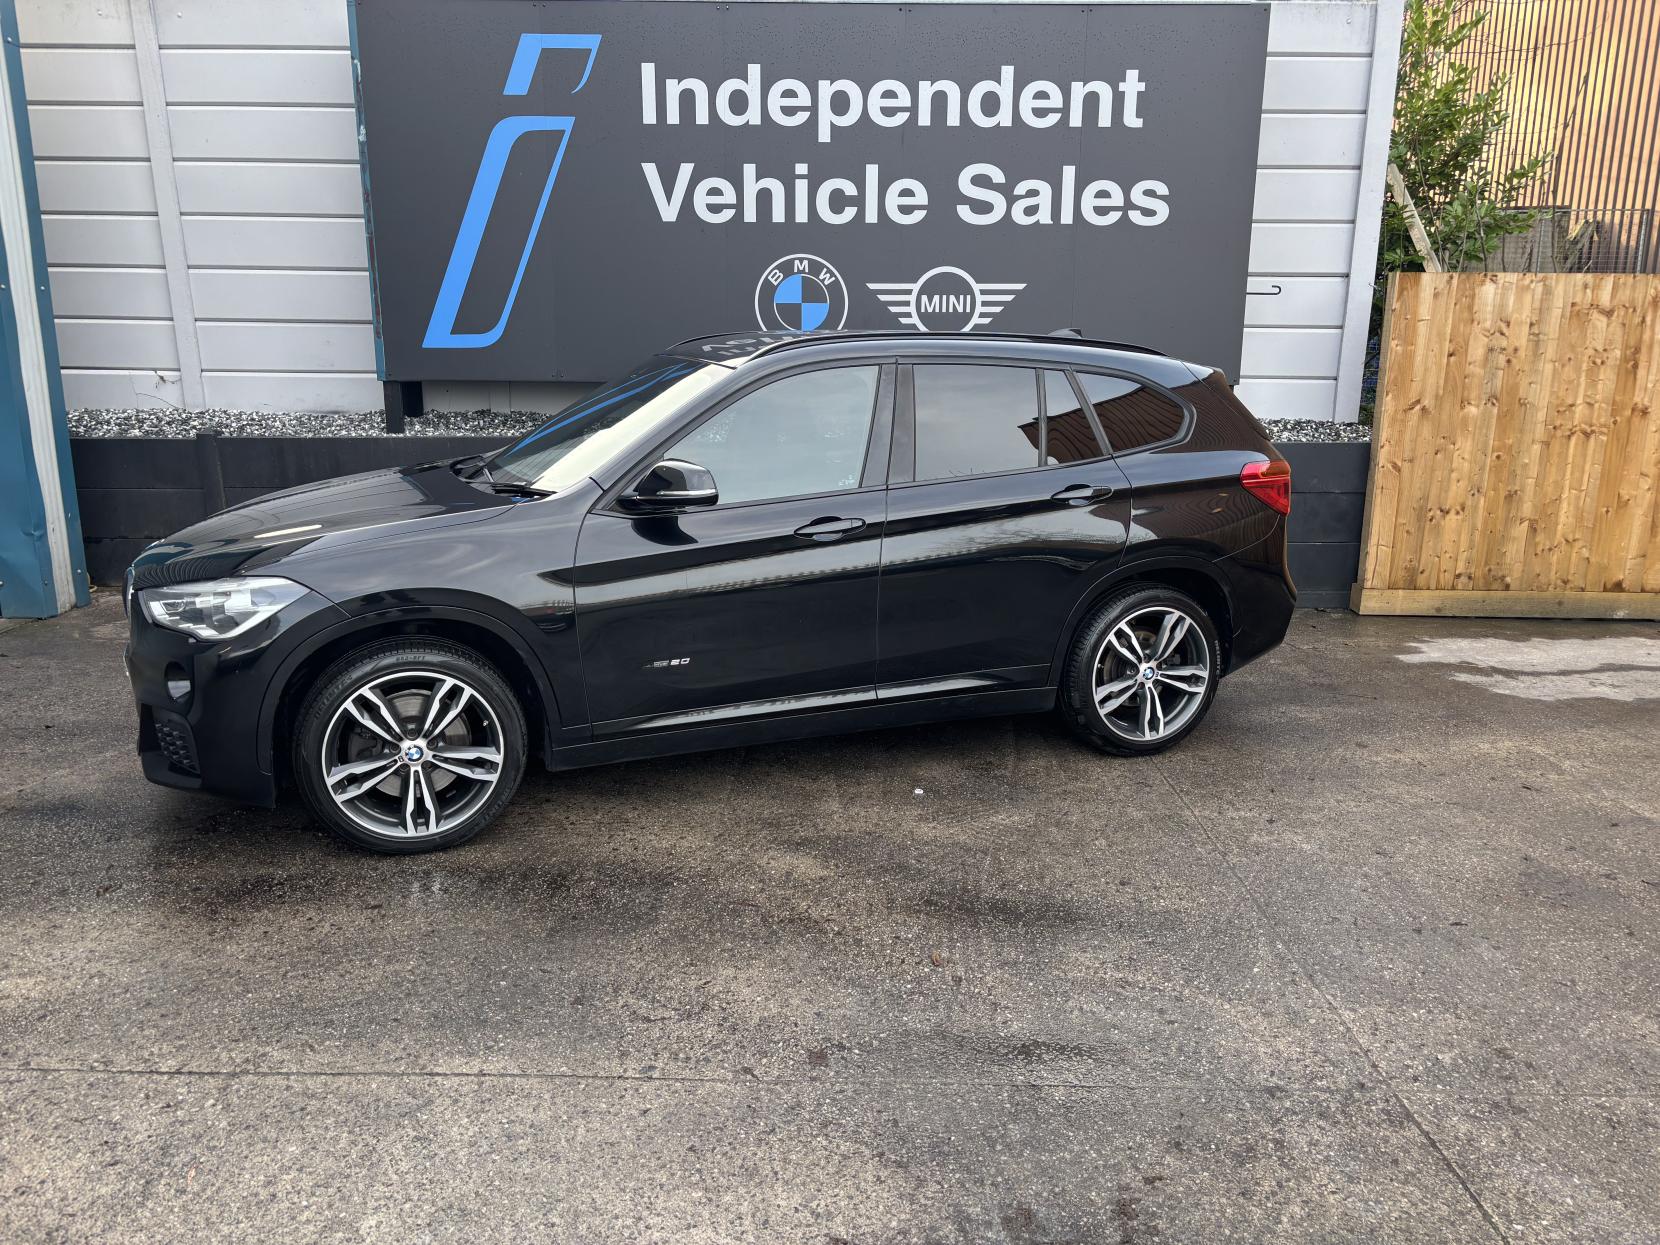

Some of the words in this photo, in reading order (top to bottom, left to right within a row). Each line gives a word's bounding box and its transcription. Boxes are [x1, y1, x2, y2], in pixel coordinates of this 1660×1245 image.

[641, 63, 1145, 142] Independent
[641, 163, 928, 224] Vehicle
[957, 163, 1169, 226] Sales
[767, 259, 836, 287] BMW
[920, 294, 971, 313] MINI
